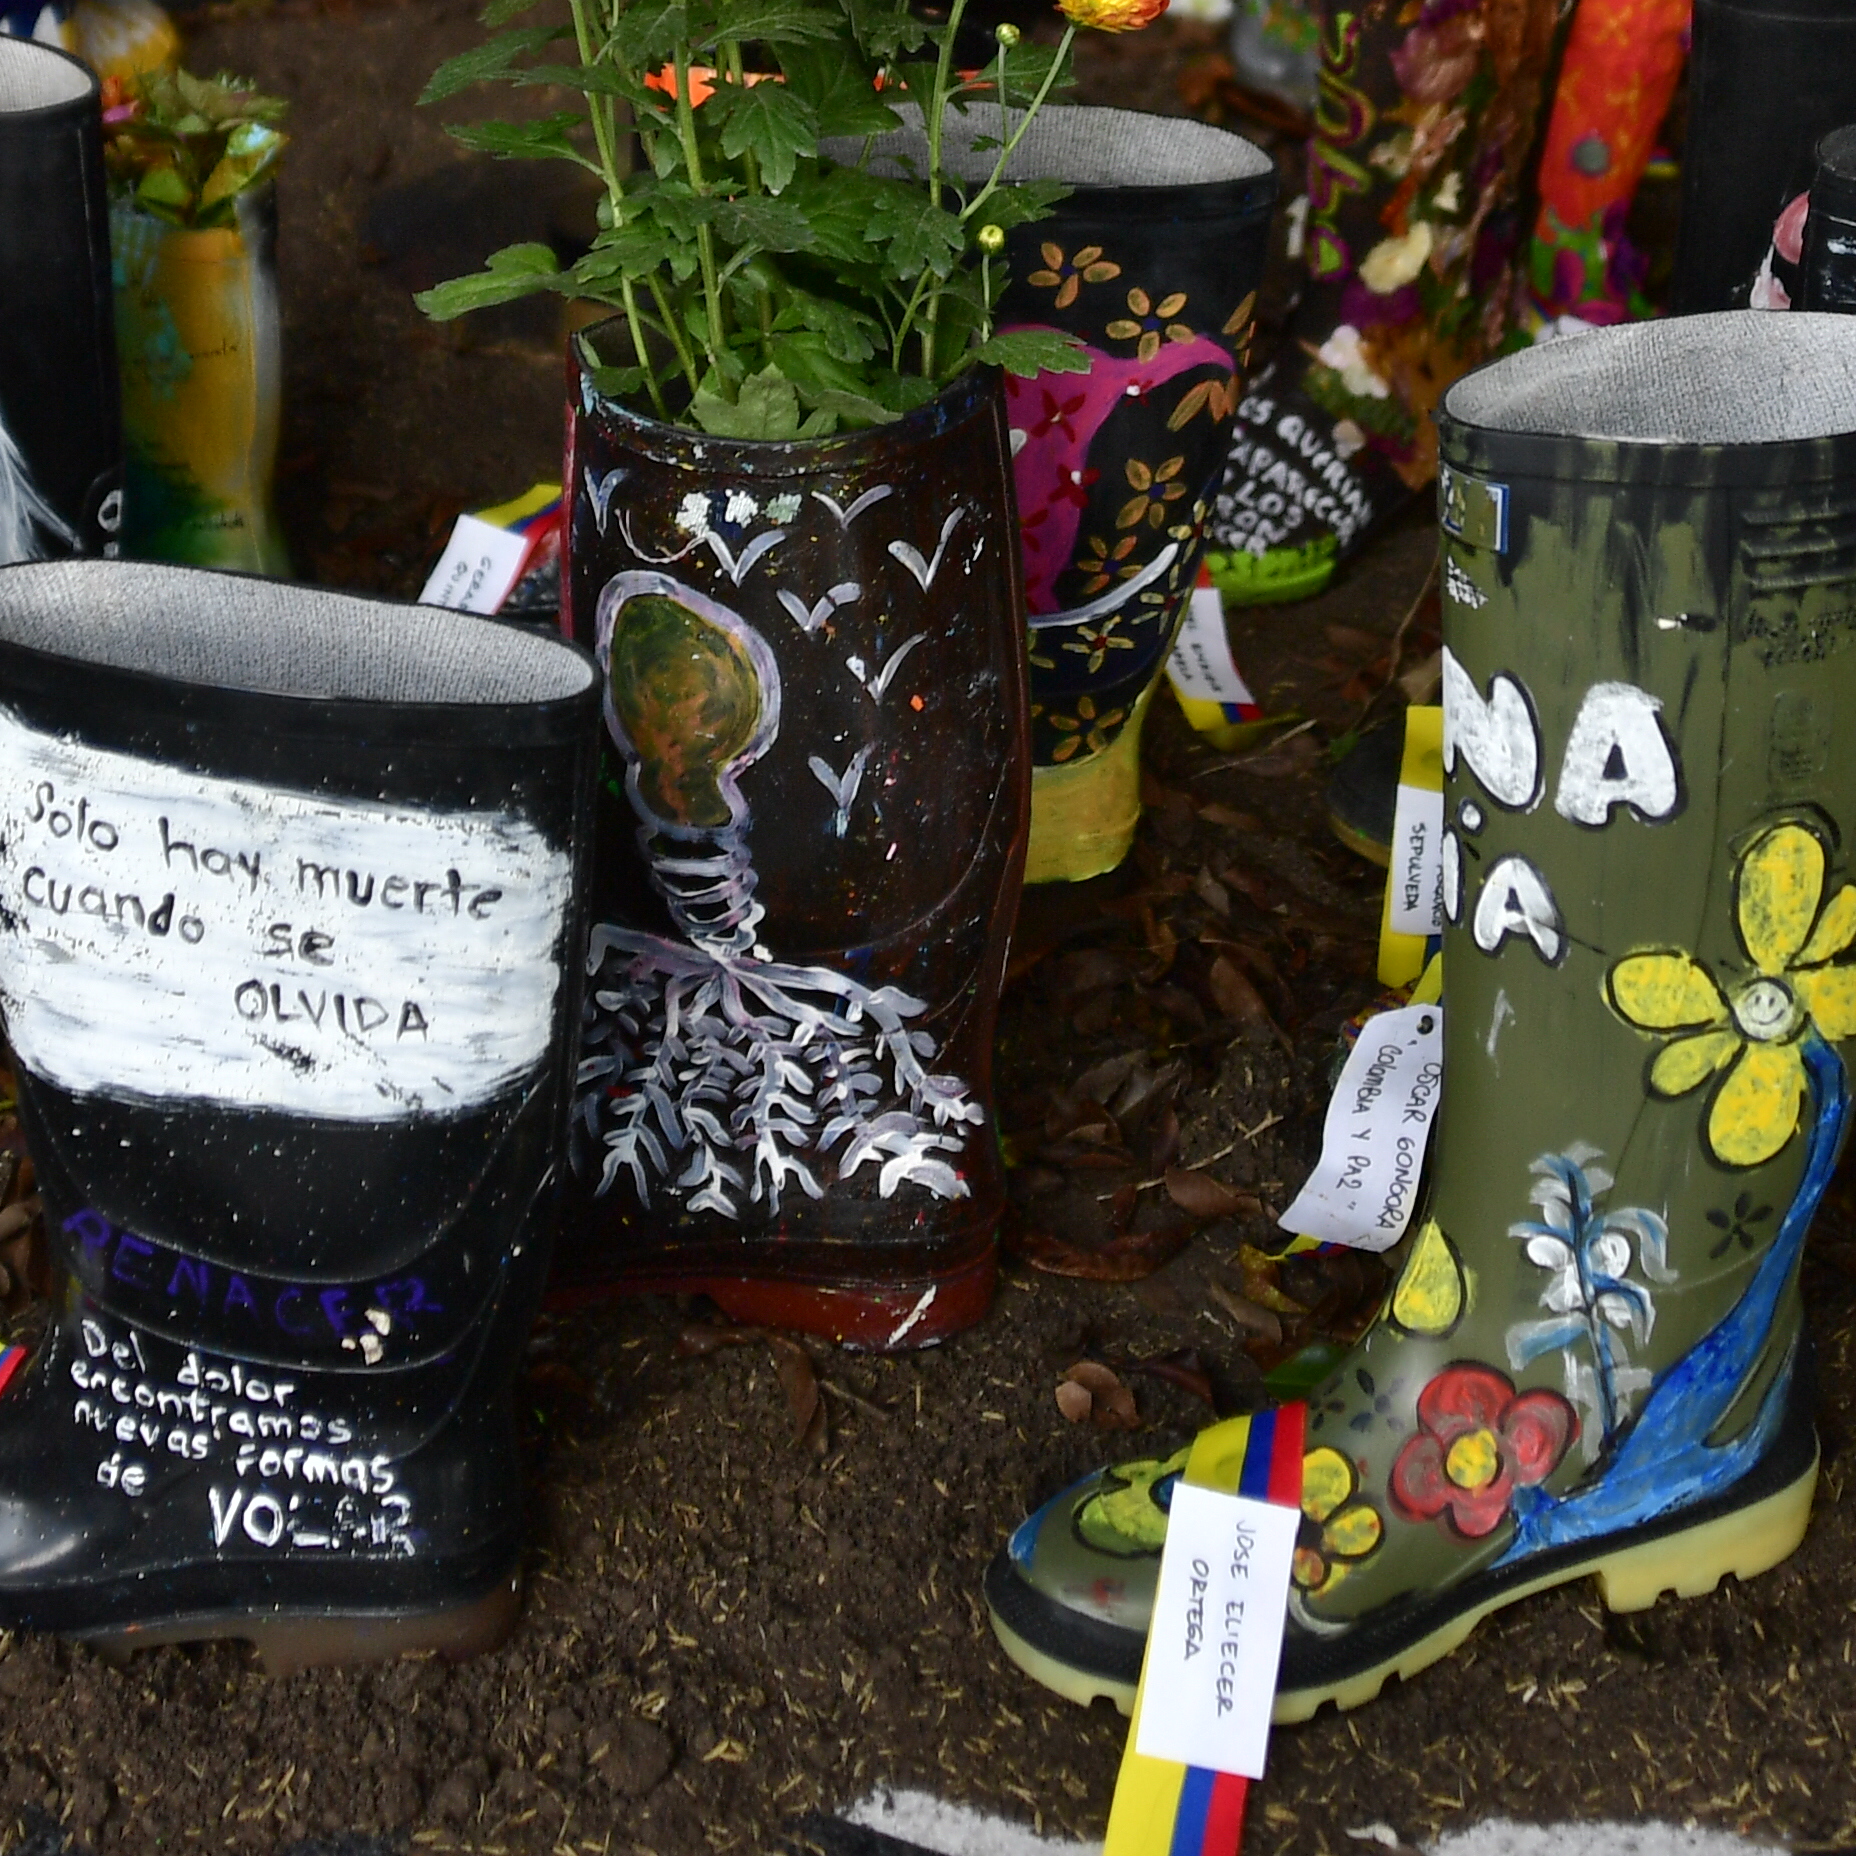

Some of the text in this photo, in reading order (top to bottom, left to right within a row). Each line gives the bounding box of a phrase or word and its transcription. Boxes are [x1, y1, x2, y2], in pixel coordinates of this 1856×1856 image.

[26, 781, 502, 921] Solo hay muerte
[1403, 822, 1427, 911] SEPULVEDA
[266, 923, 334, 967] se
[234, 978, 428, 1043] OLVIDA
[1351, 1128, 1373, 1142] Y
[1375, 1062, 1442, 1230] OSCAR GONGORA
[63, 1207, 443, 1335] RENACER
[71, 1360, 352, 1444] encontramos
[81, 1318, 295, 1407] Del dolor
[75, 1400, 394, 1494] nuevas formas
[97, 1452, 145, 1497] de
[1183, 1559, 1211, 1662] ORTEGA
[1216, 1520, 1256, 1718] JOSE ELIECER
